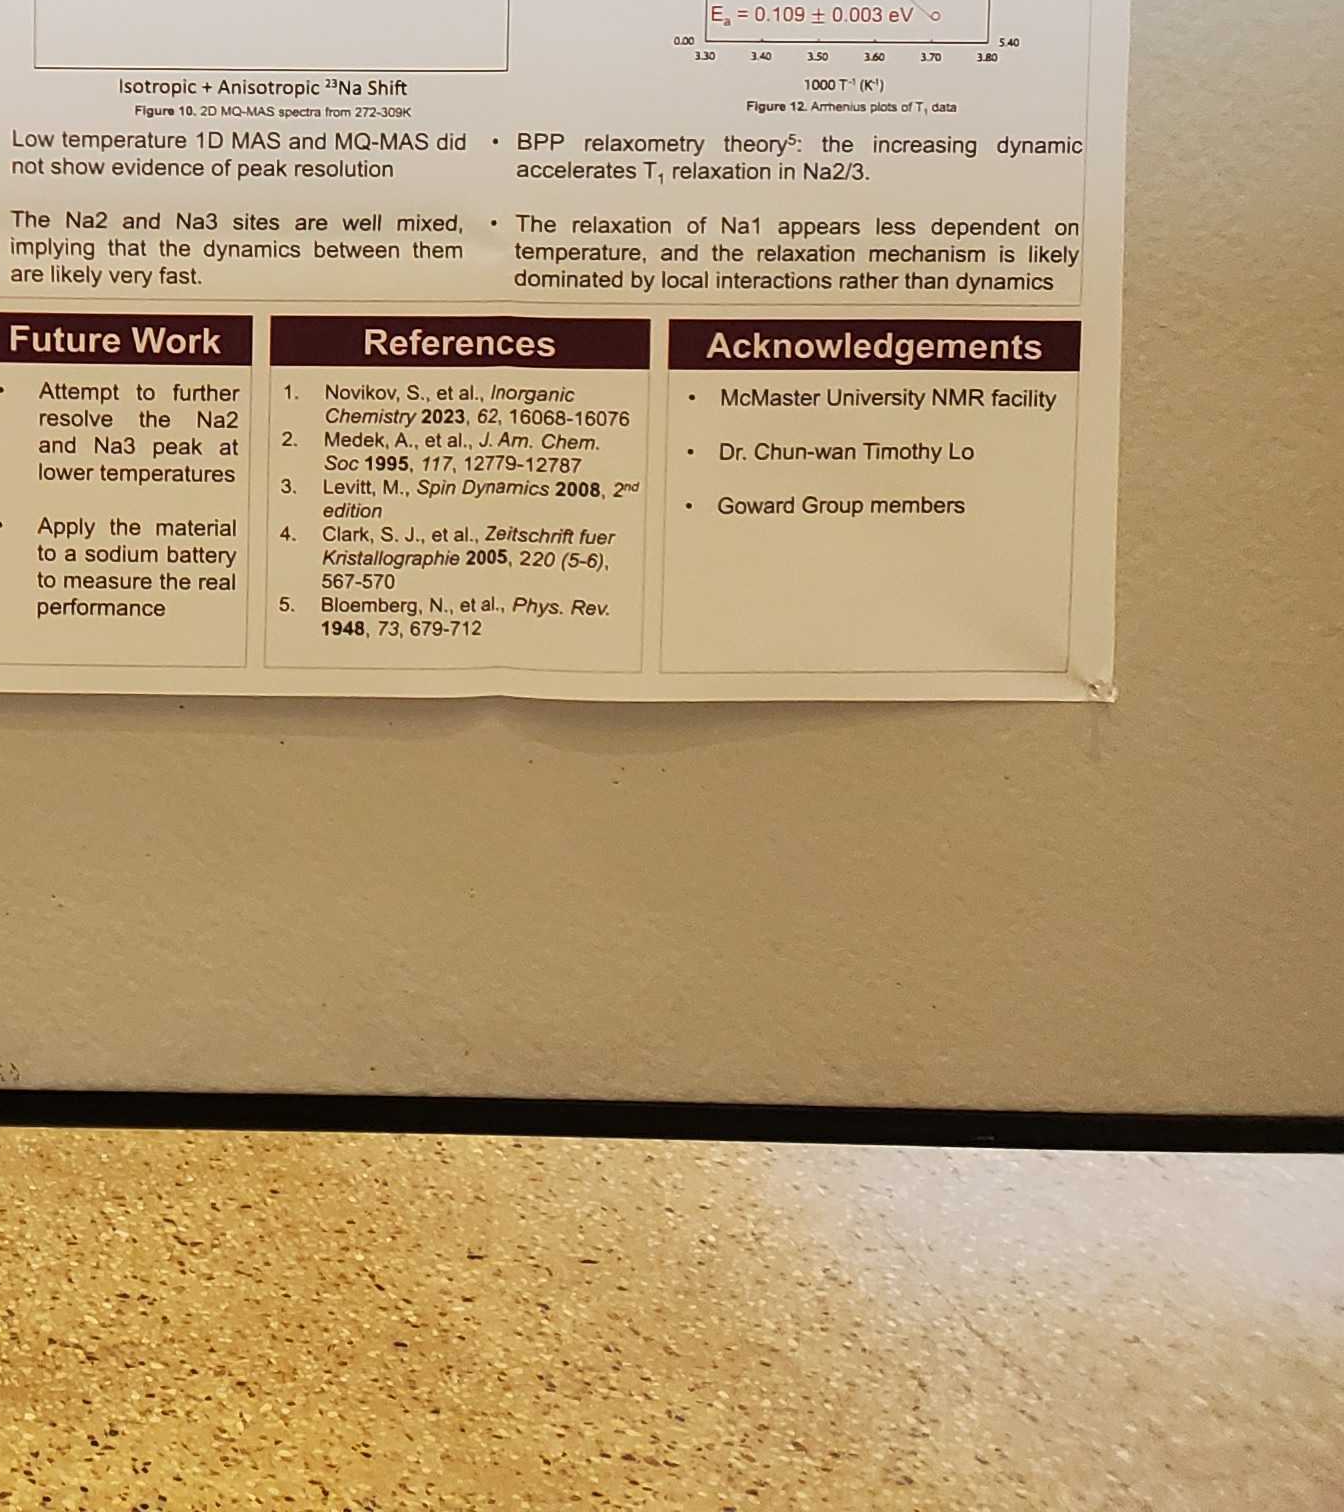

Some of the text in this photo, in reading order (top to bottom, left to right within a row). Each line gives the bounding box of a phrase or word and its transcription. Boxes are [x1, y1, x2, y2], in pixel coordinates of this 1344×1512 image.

[12, 129, 467, 153] Low temperature 1D MAS and MQ-MAS did
[10, 325, 222, 355] Future Work
[364, 328, 556, 357] References
[706, 331, 1043, 366] Acknowledgements
[38, 381, 241, 404] Attempt to further
[325, 383, 576, 405] Novikov, S., et al., Inorganic
[720, 387, 1057, 412] McMaster University NMR facility
[719, 441, 975, 464] Dr. Chun-wan Timothy Lo
[717, 495, 966, 517] Goward Group members
